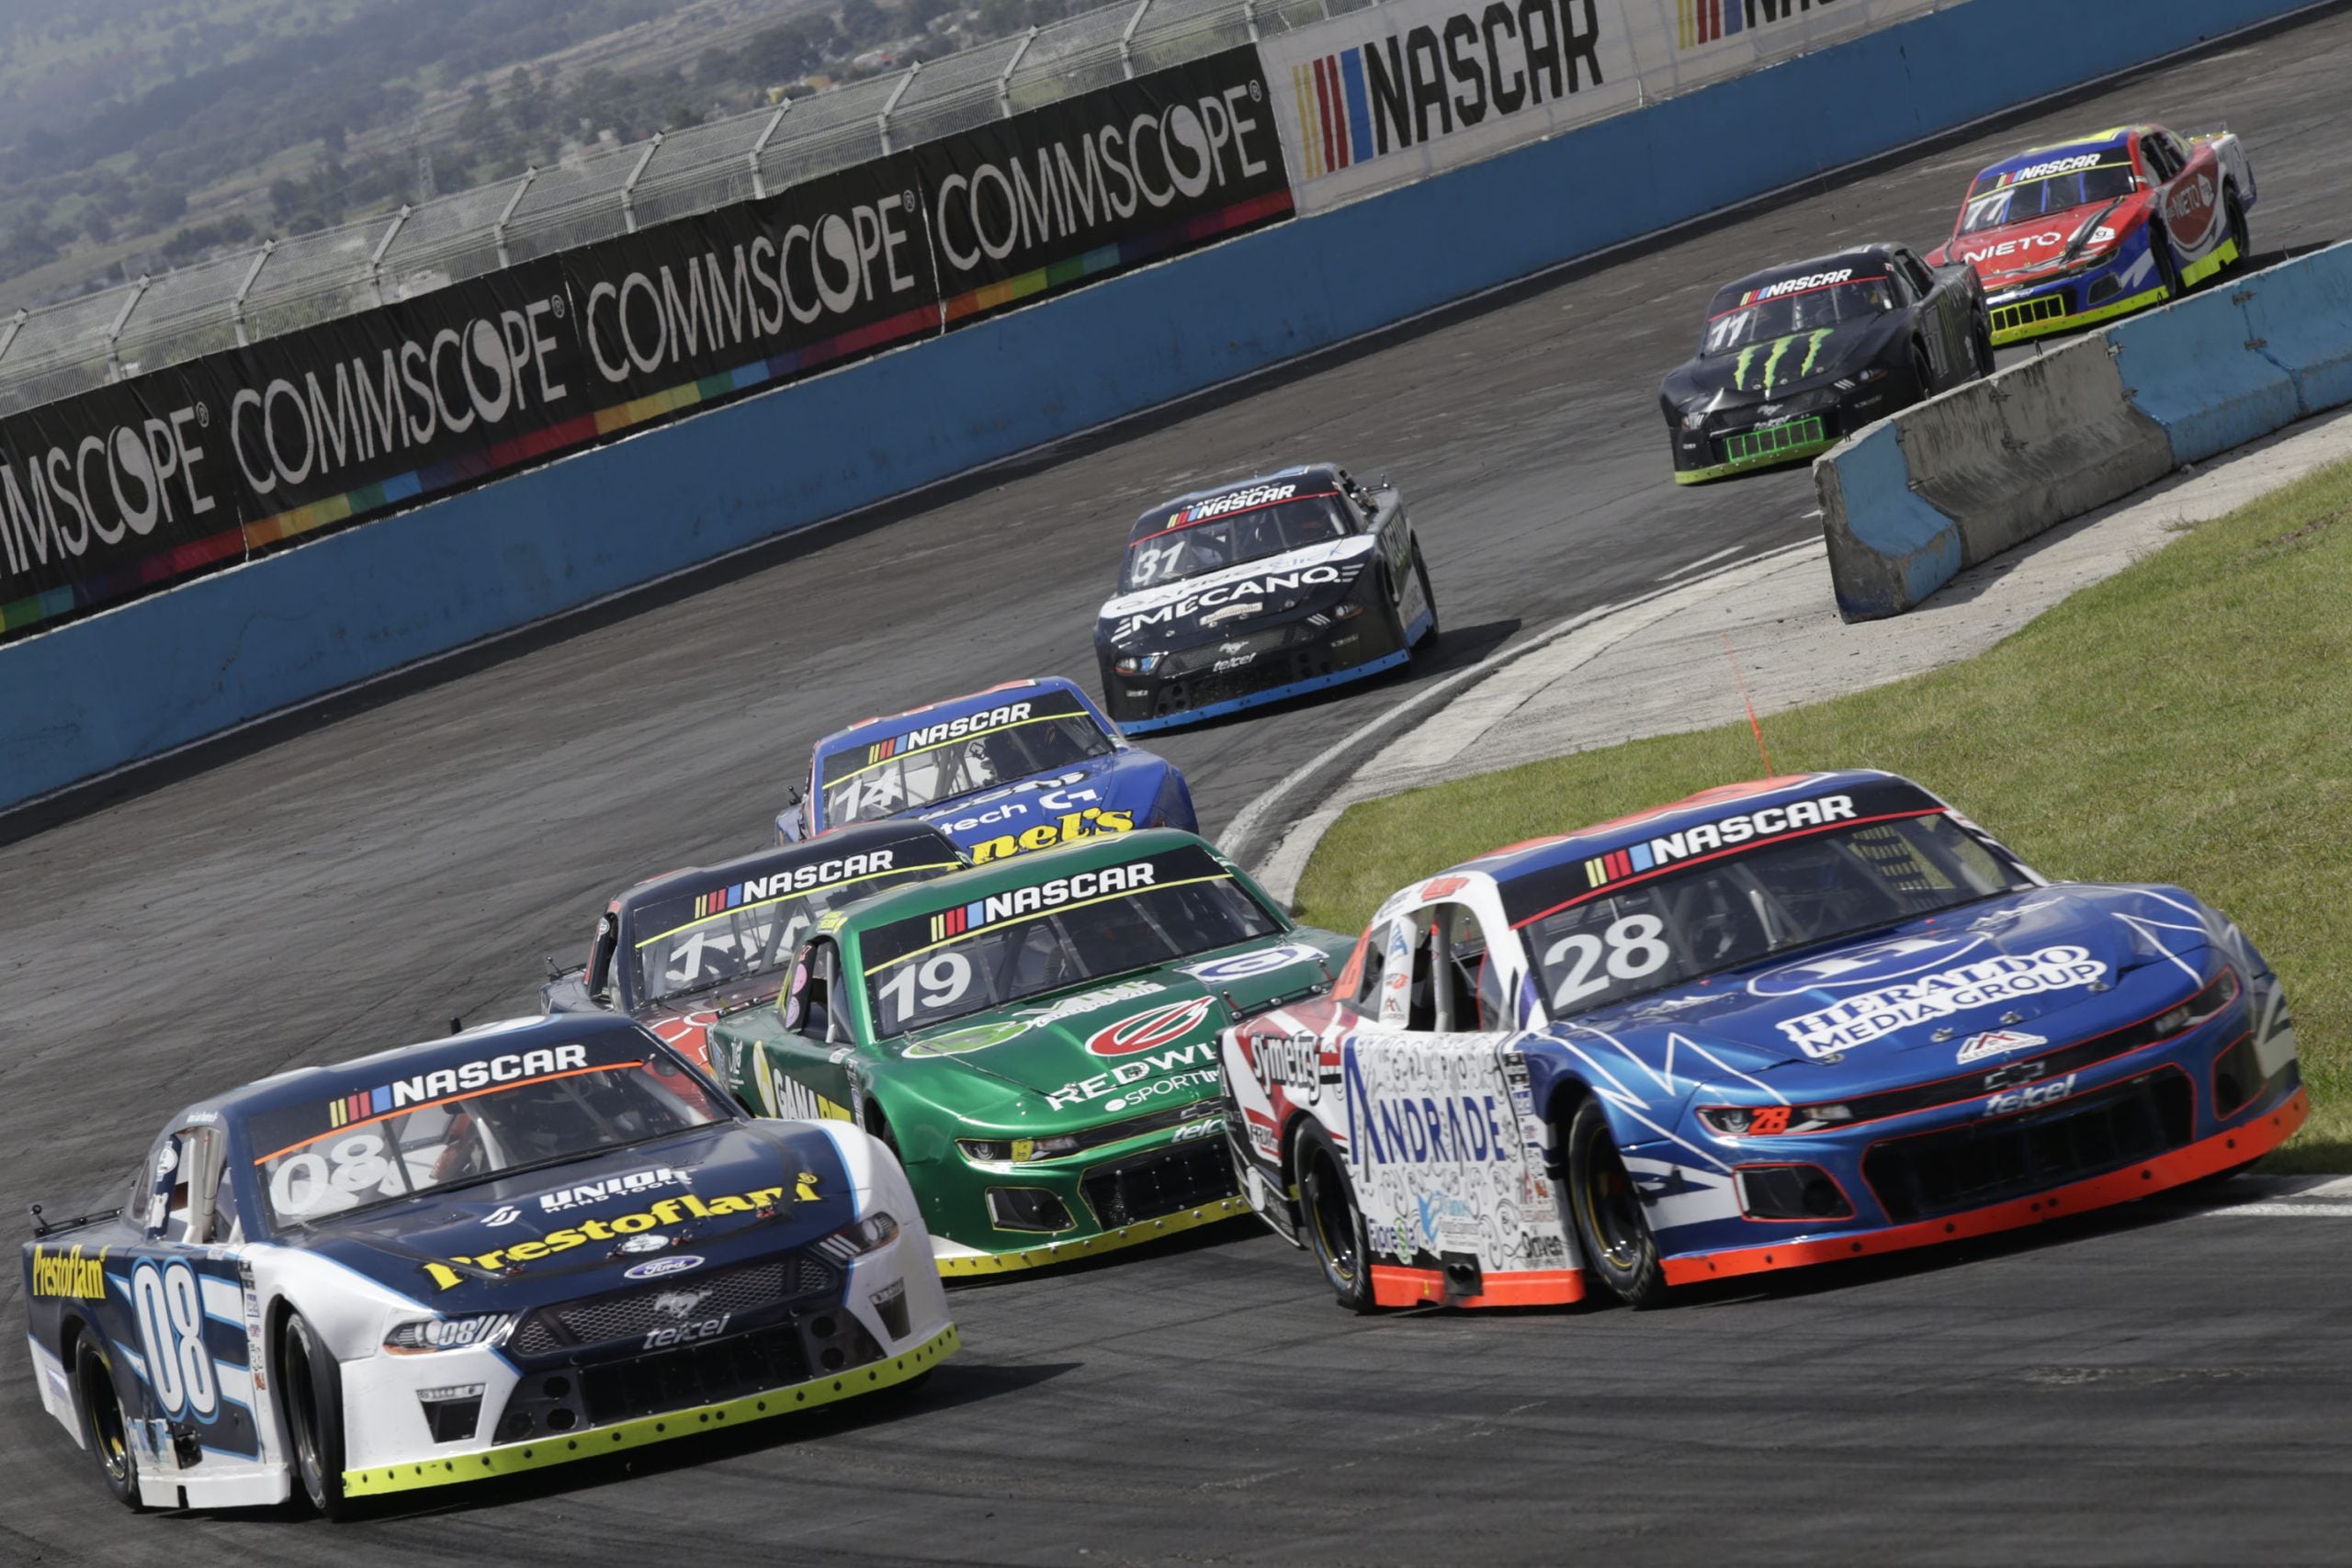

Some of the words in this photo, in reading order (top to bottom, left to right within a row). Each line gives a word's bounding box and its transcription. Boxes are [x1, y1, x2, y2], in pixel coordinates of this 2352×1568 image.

[1364, 0, 1604, 155] NASCAR
[2020, 153, 2101, 179] NASCAR
[1964, 189, 2015, 230] 77
[1962, 231, 2062, 265] NIETO
[1766, 268, 1852, 299] NASCAR
[1197, 484, 1296, 519] NASCAR
[1131, 540, 1186, 585] 31
[1131, 565, 1340, 632] MECANO
[907, 703, 1031, 750] NASCAR
[1649, 795, 1857, 865] NASCAR
[742, 850, 893, 903] NASCAR
[984, 863, 1155, 922] NASCAR
[877, 952, 972, 1023] 19
[1544, 914, 1669, 1010] 28
[1785, 948, 2080, 1036] HERALDO
[1812, 1001, 1939, 1054] MEDIA
[1952, 964, 2098, 1005] GROUP
[390, 1044, 587, 1108] NASCAR
[1044, 1041, 1217, 1111] REDWI
[1344, 1036, 1506, 1166] ANDRADE
[1171, 1119, 1225, 1144] telc
[1748, 1106, 1791, 1136] 28
[269, 1134, 385, 1215] 08
[132, 1259, 217, 1418] 08
